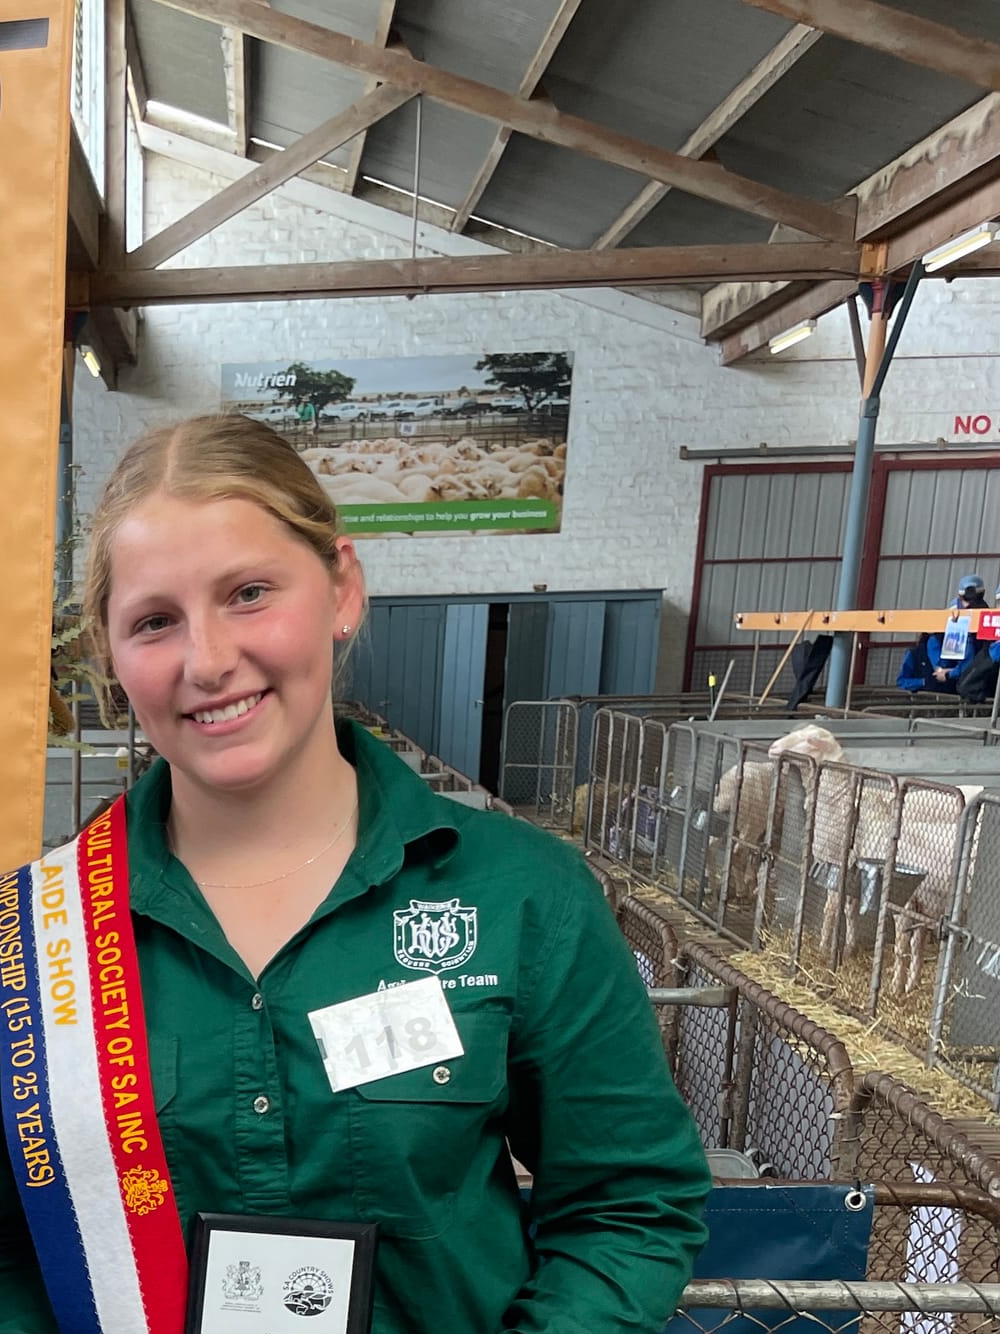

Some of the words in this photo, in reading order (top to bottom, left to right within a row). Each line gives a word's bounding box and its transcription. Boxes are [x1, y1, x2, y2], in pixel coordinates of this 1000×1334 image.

[234, 371, 297, 388] Nutrien
[954, 415, 991, 434] NO
[360, 513, 375, 522] and
[425, 513, 434, 521] to
[435, 512, 453, 522] help
[453, 513, 468, 522] you
[470, 512, 491, 522] grow
[492, 512, 511, 521] your
[40, 859, 68, 930] AIDE
[46, 938, 79, 1025] SHOW
[95, 931, 130, 1030] SOCIETY
[458, 974, 498, 988] Team
[0, 997, 32, 1032] (15
[11, 1033, 35, 1068] TO
[107, 1037, 135, 1067] OF
[344, 1016, 437, 1069] 118
[12, 1071, 38, 1100] 25
[111, 1073, 139, 1109] SA
[16, 1102, 56, 1188] YEARS)
[116, 1112, 148, 1154] INC
